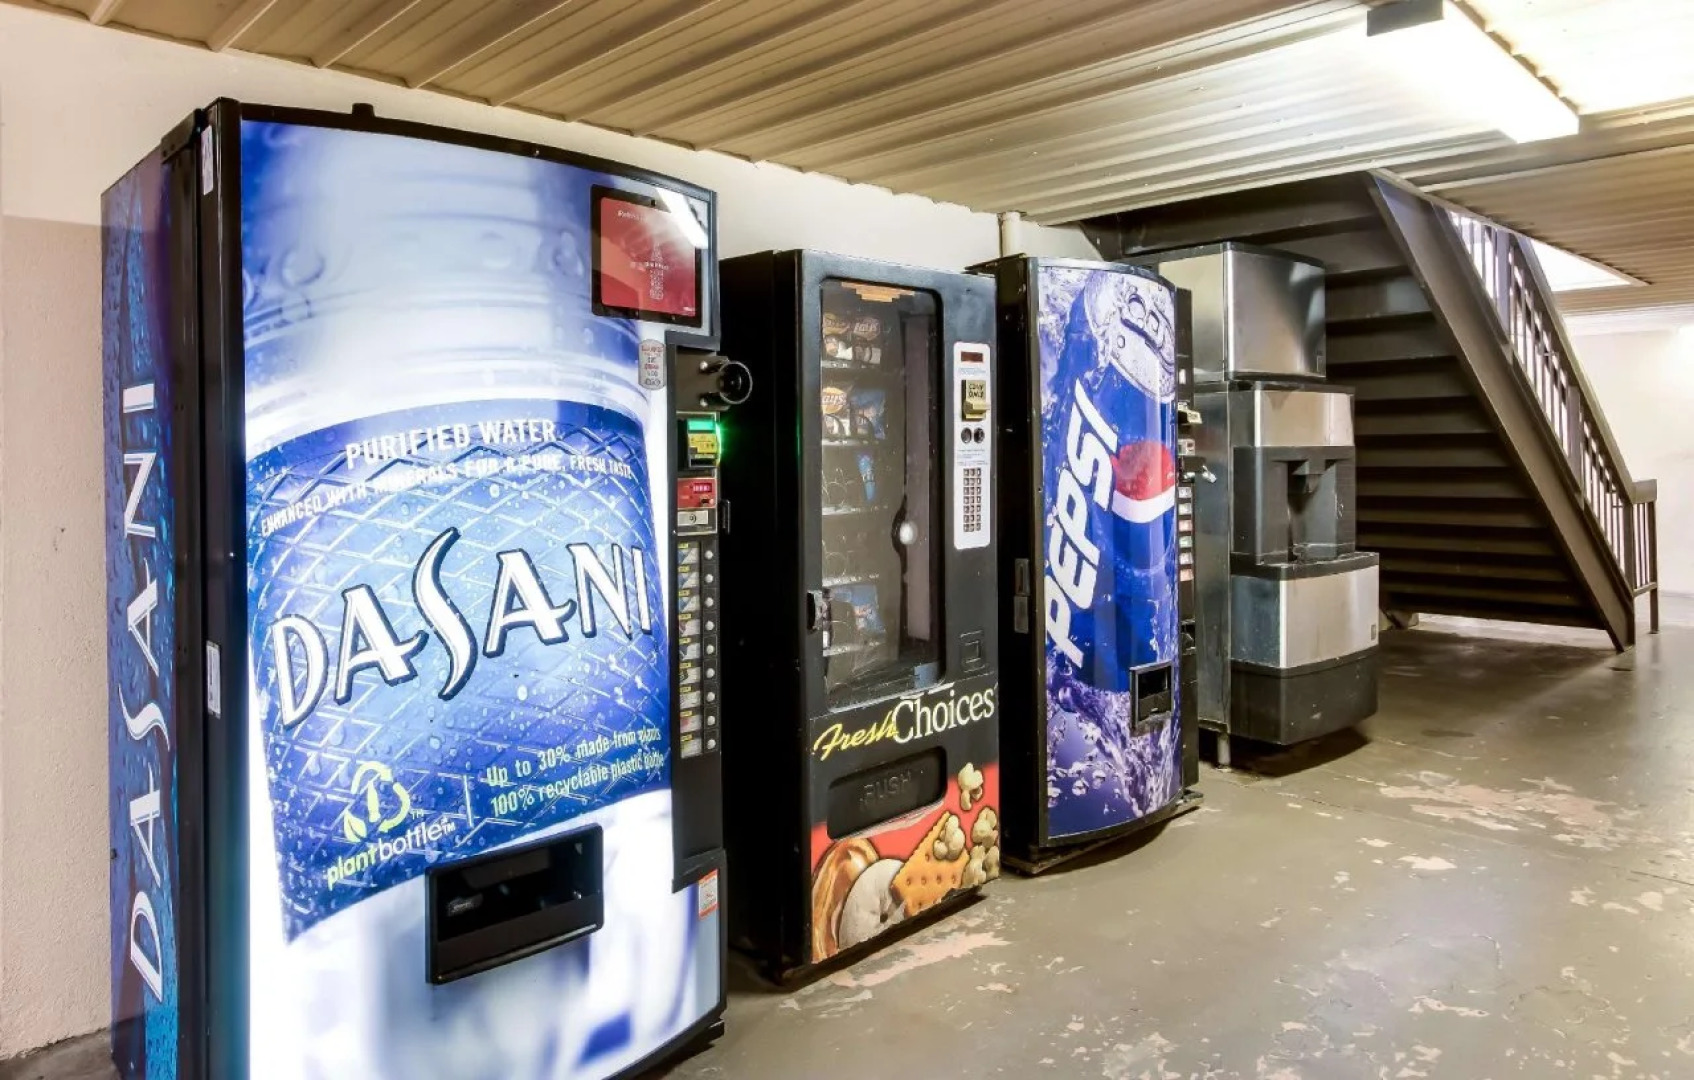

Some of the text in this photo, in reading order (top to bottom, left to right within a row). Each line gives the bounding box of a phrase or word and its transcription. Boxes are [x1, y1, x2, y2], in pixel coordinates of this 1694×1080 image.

[346, 419, 557, 470] PURIFIED WATER
[261, 496, 322, 538] ENHANCED
[326, 481, 367, 508] WITH
[570, 455, 606, 475] FRESH
[1045, 378, 1119, 669] PEPSI
[271, 526, 653, 731] DASANI
[117, 380, 171, 1003] DASANI
[813, 688, 995, 762] Fresh Choices
[486, 765, 508, 787] Up
[515, 759, 532, 778] to
[537, 746, 571, 771] 30%
[575, 735, 610, 760] made
[613, 730, 636, 749] from
[490, 786, 536, 818] 100%
[538, 766, 609, 802] recyclable
[611, 749, 643, 781] plastic
[863, 770, 912, 799] PUSH
